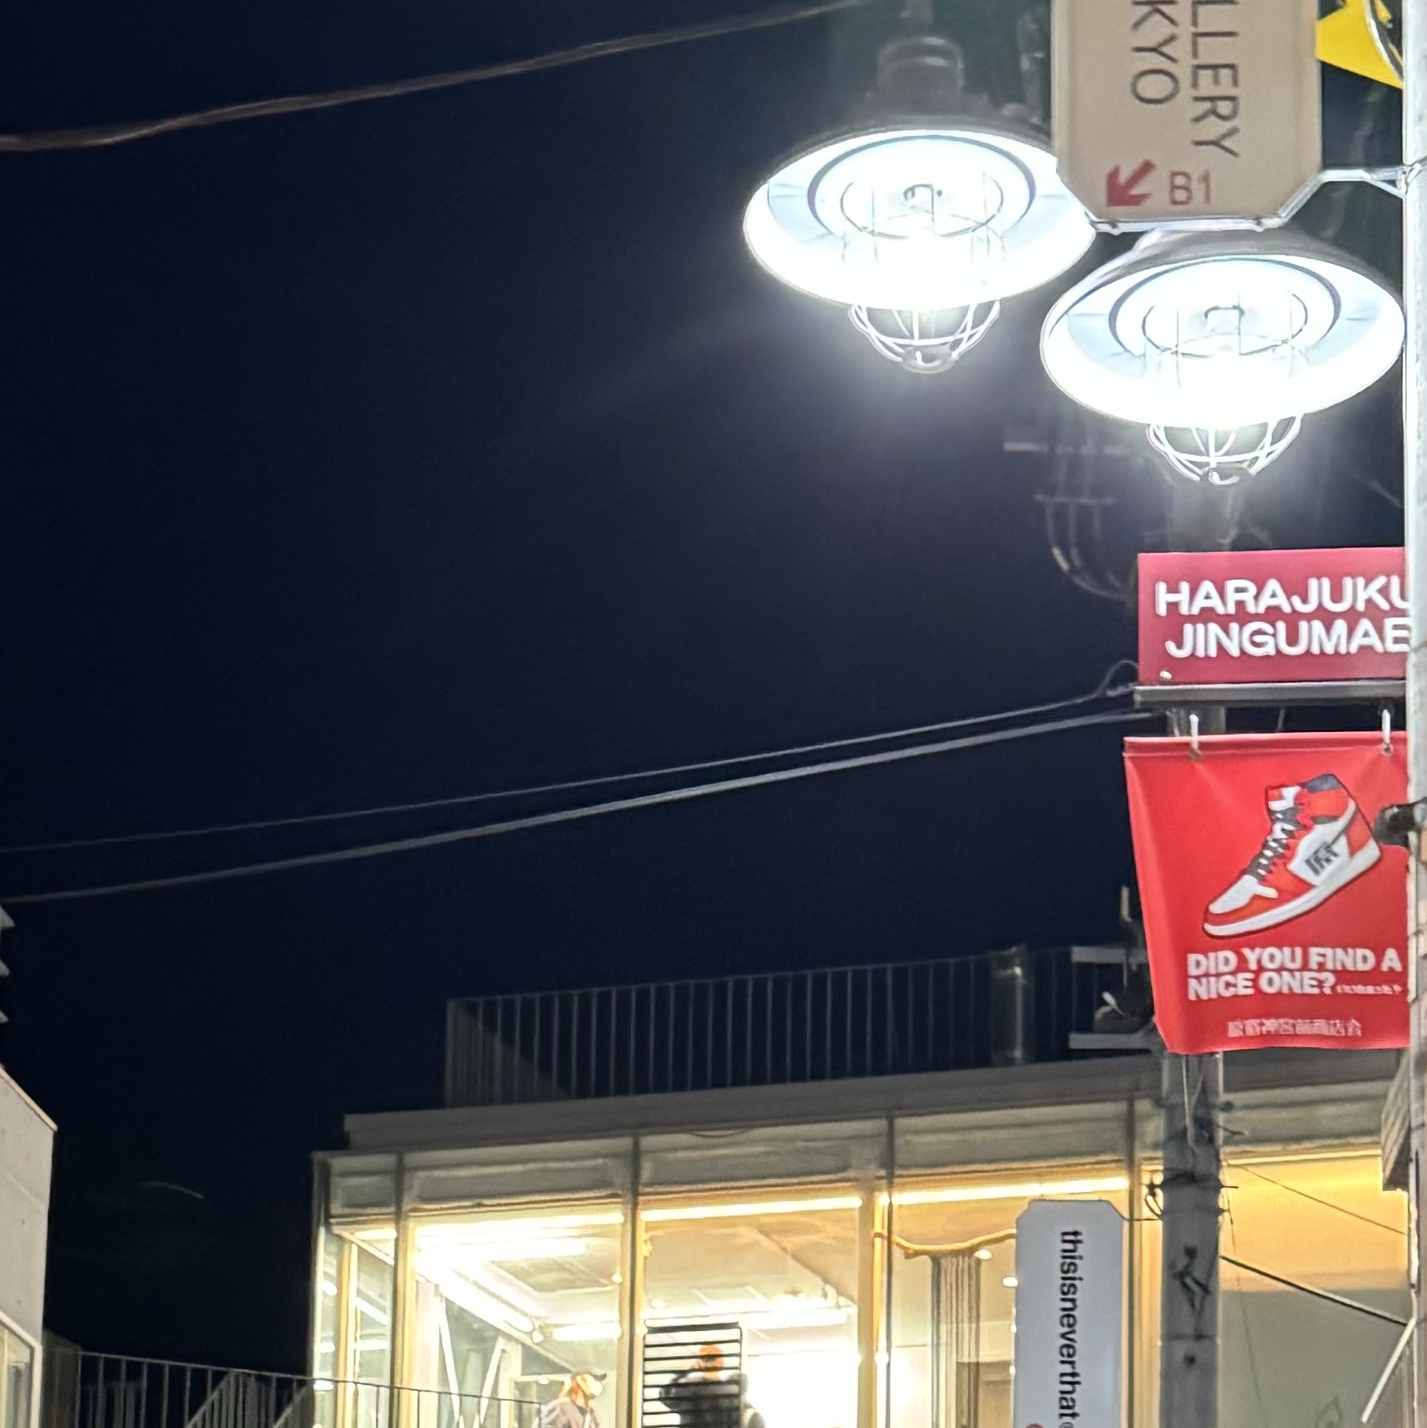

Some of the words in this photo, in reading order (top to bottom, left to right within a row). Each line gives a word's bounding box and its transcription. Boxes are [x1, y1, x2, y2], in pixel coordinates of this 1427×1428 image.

[1168, 170, 1212, 206] B1
[1164, 616, 1412, 659] JINGUMAE
[1187, 951, 1237, 977] DID
[1241, 946, 1303, 971] YOU
[1308, 947, 1376, 972] FIND
[1381, 947, 1403, 972] A
[1187, 972, 1255, 1001] NICE
[1259, 971, 1336, 995] ONE?
